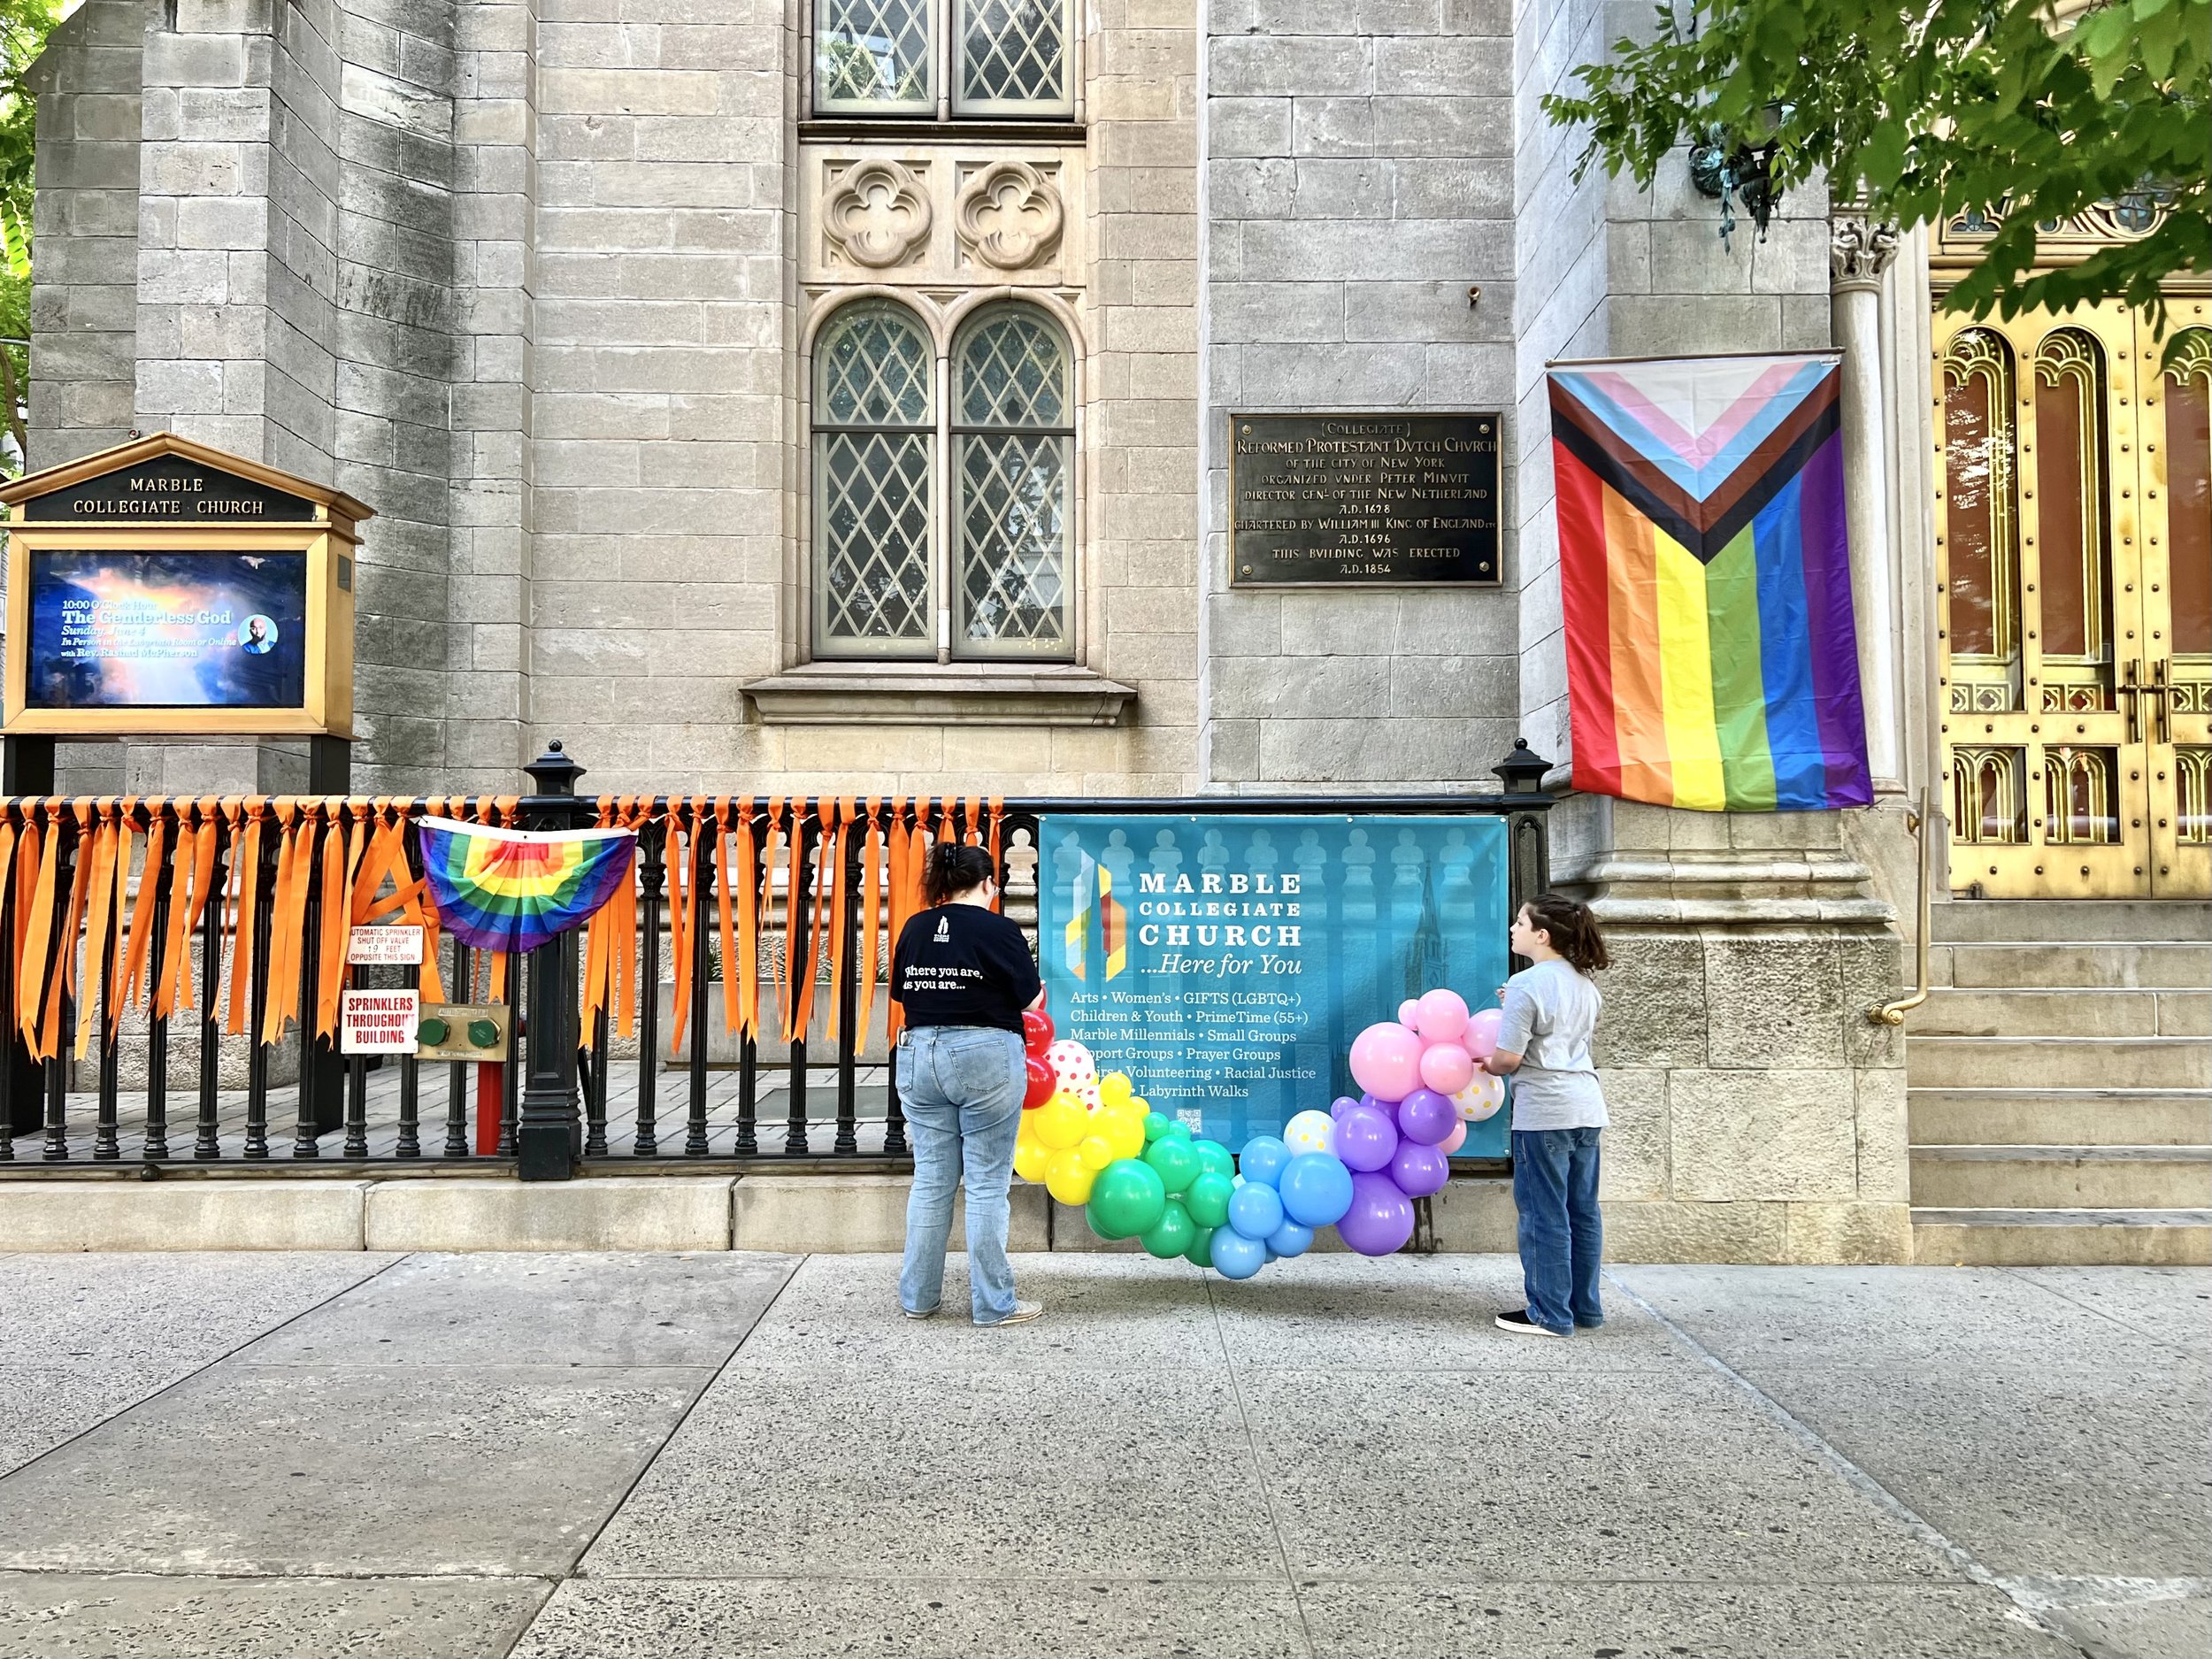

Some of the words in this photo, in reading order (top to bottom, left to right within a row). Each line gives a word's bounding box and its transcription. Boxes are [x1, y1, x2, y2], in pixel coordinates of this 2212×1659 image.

[1236, 439, 1303, 454] REFORMED
[1306, 437, 1391, 453] PROTESTANT
[1286, 459, 1300, 469] OF
[1303, 459, 1326, 469] THE
[1331, 458, 1357, 469] CITY
[1361, 458, 1376, 468] OF
[1380, 457, 1409, 468] NEW
[1415, 457, 1445, 468] YORK
[1261, 474, 1327, 484] ORGANIZED
[1380, 472, 1416, 484] PETER
[130, 479, 203, 491] MARBLE
[1245, 489, 1295, 501] DIRECTOR
[1333, 489, 1346, 500] OF
[1349, 489, 1371, 500] THE
[1378, 488, 1407, 499] NEW
[1411, 488, 1487, 499] NETHERLAND
[73, 500, 180, 513] COLLEGIATE
[196, 501, 263, 513] CHURCH
[1234, 520, 1296, 530] CHARTERED
[1301, 519, 1315, 530] BY
[1318, 518, 1368, 529] WILLIAM
[1386, 518, 1412, 529] KING
[1416, 519, 1432, 529] OF
[1364, 534, 1391, 544] 1696
[1272, 549, 1300, 559] THIS
[1372, 549, 1399, 558] WAS
[1409, 548, 1460, 558] ERECTED
[1364, 564, 1391, 574] 1854
[63, 600, 90, 610] 10:00
[62, 611, 96, 625] The
[99, 611, 195, 625] Genderless
[196, 610, 232, 625] God
[61, 637, 73, 646] In
[73, 637, 101, 647] Person
[208, 637, 237, 647] Online
[76, 648, 99, 657] Rev.
[1139, 872, 1301, 895] MARBLE
[1139, 902, 1301, 917] COLLEGIATE
[1139, 924, 1302, 947] CHURCH
[1217, 954, 1253, 979] for
[1260, 955, 1302, 974] You
[938, 967, 958, 979] you
[960, 968, 984, 980] are,
[915, 980, 937, 992] you
[349, 997, 413, 1011] SPRINKLERS
[1071, 992, 1099, 1003] Arts
[1110, 992, 1171, 1004] Women's
[1184, 992, 1229, 1004] GIFTS
[1232, 992, 1302, 1007] (LGBTQ+)
[1071, 1010, 1128, 1022] Children
[1131, 1011, 1141, 1022] &
[1144, 1010, 1184, 1023] Youth
[1273, 1010, 1309, 1025] (55+)
[356, 1030, 404, 1044] BUILDING
[1071, 1028, 1118, 1041] Marble
[1120, 1028, 1195, 1041] Millennials
[1207, 1029, 1246, 1041] Small
[1248, 1030, 1297, 1044] Groups
[1125, 1048, 1174, 1062] Groups
[1186, 1048, 1230, 1062] Prayer
[1233, 1048, 1281, 1063] Groups
[1125, 1065, 1212, 1081] Volunteering
[1225, 1066, 1266, 1079] Racial
[1268, 1066, 1317, 1079] Justice
[1140, 1085, 1205, 1099] Labyrinth
[1208, 1085, 1249, 1097] Walks
